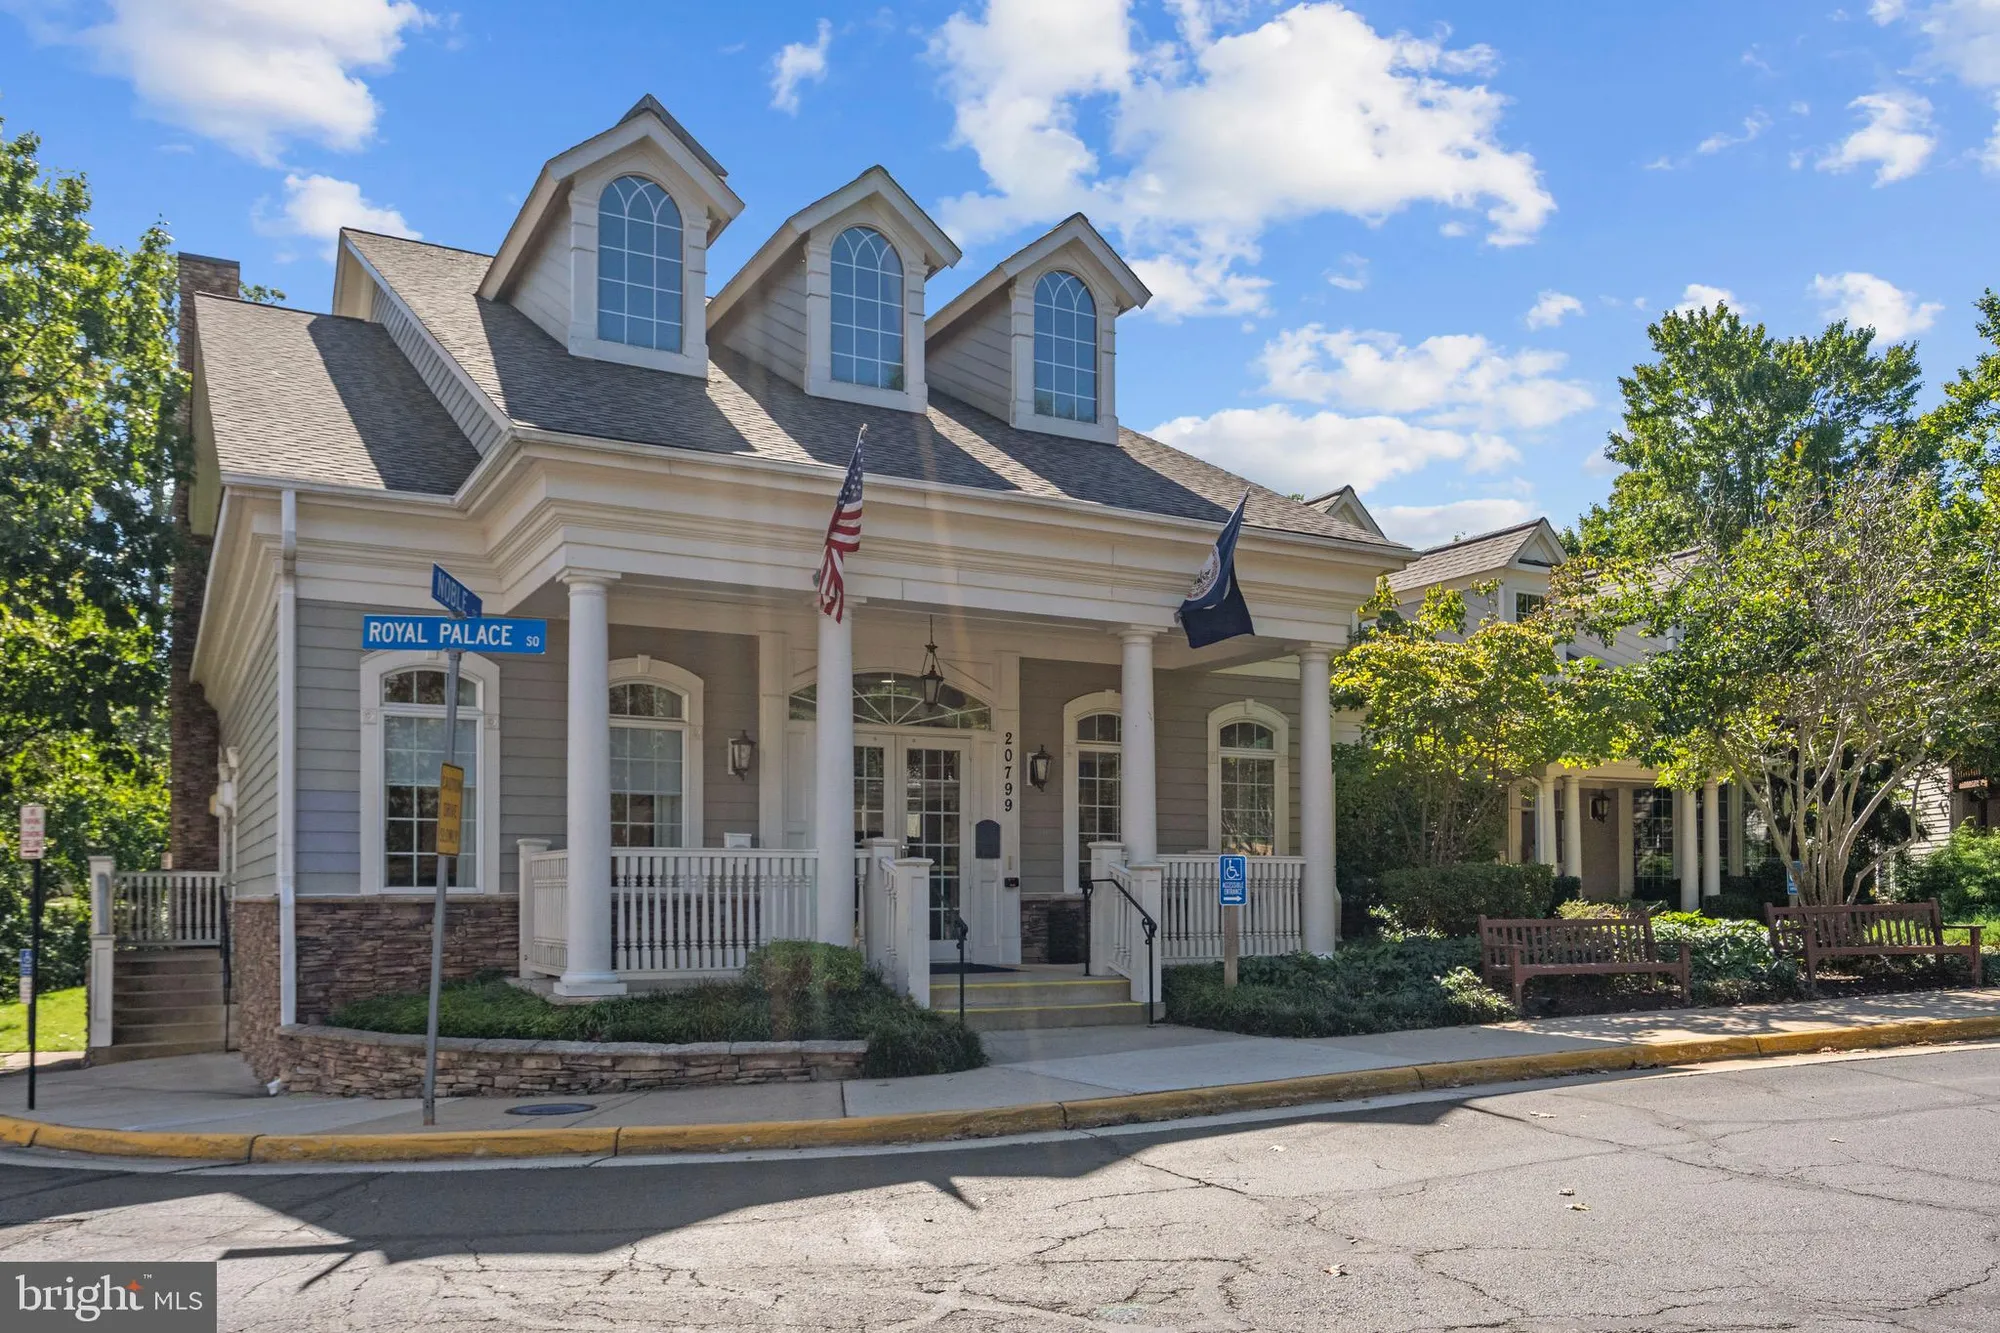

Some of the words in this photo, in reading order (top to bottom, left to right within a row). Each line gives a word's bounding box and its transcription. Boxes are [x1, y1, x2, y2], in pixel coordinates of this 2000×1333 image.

[437, 571, 468, 613] NOBLE
[368, 621, 428, 643] ROYAL
[439, 623, 513, 646] PALACE
[525, 635, 540, 648] SQ
[1004, 731, 1013, 812] 20799
